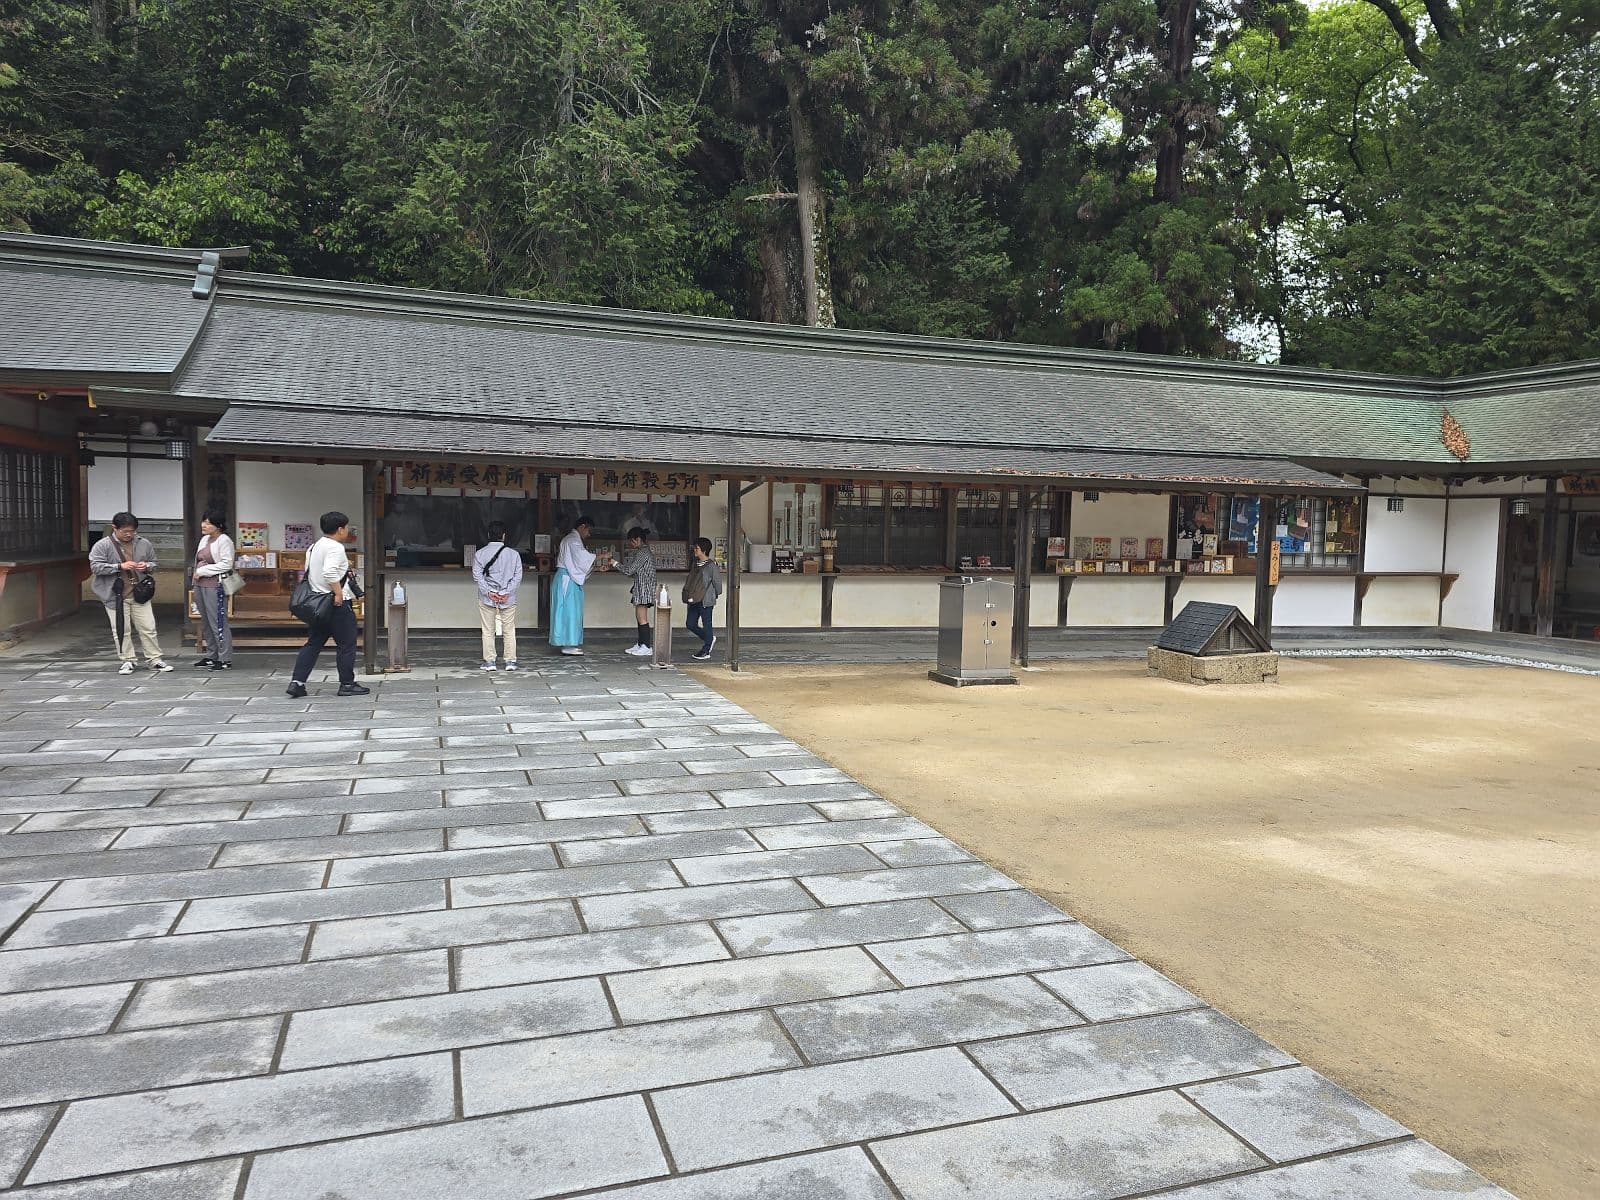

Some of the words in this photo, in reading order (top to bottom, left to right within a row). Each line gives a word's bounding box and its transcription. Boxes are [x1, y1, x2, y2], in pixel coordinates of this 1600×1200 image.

[603, 470, 700, 491] 神符授与所
[1271, 543, 1280, 582] おみくじ
